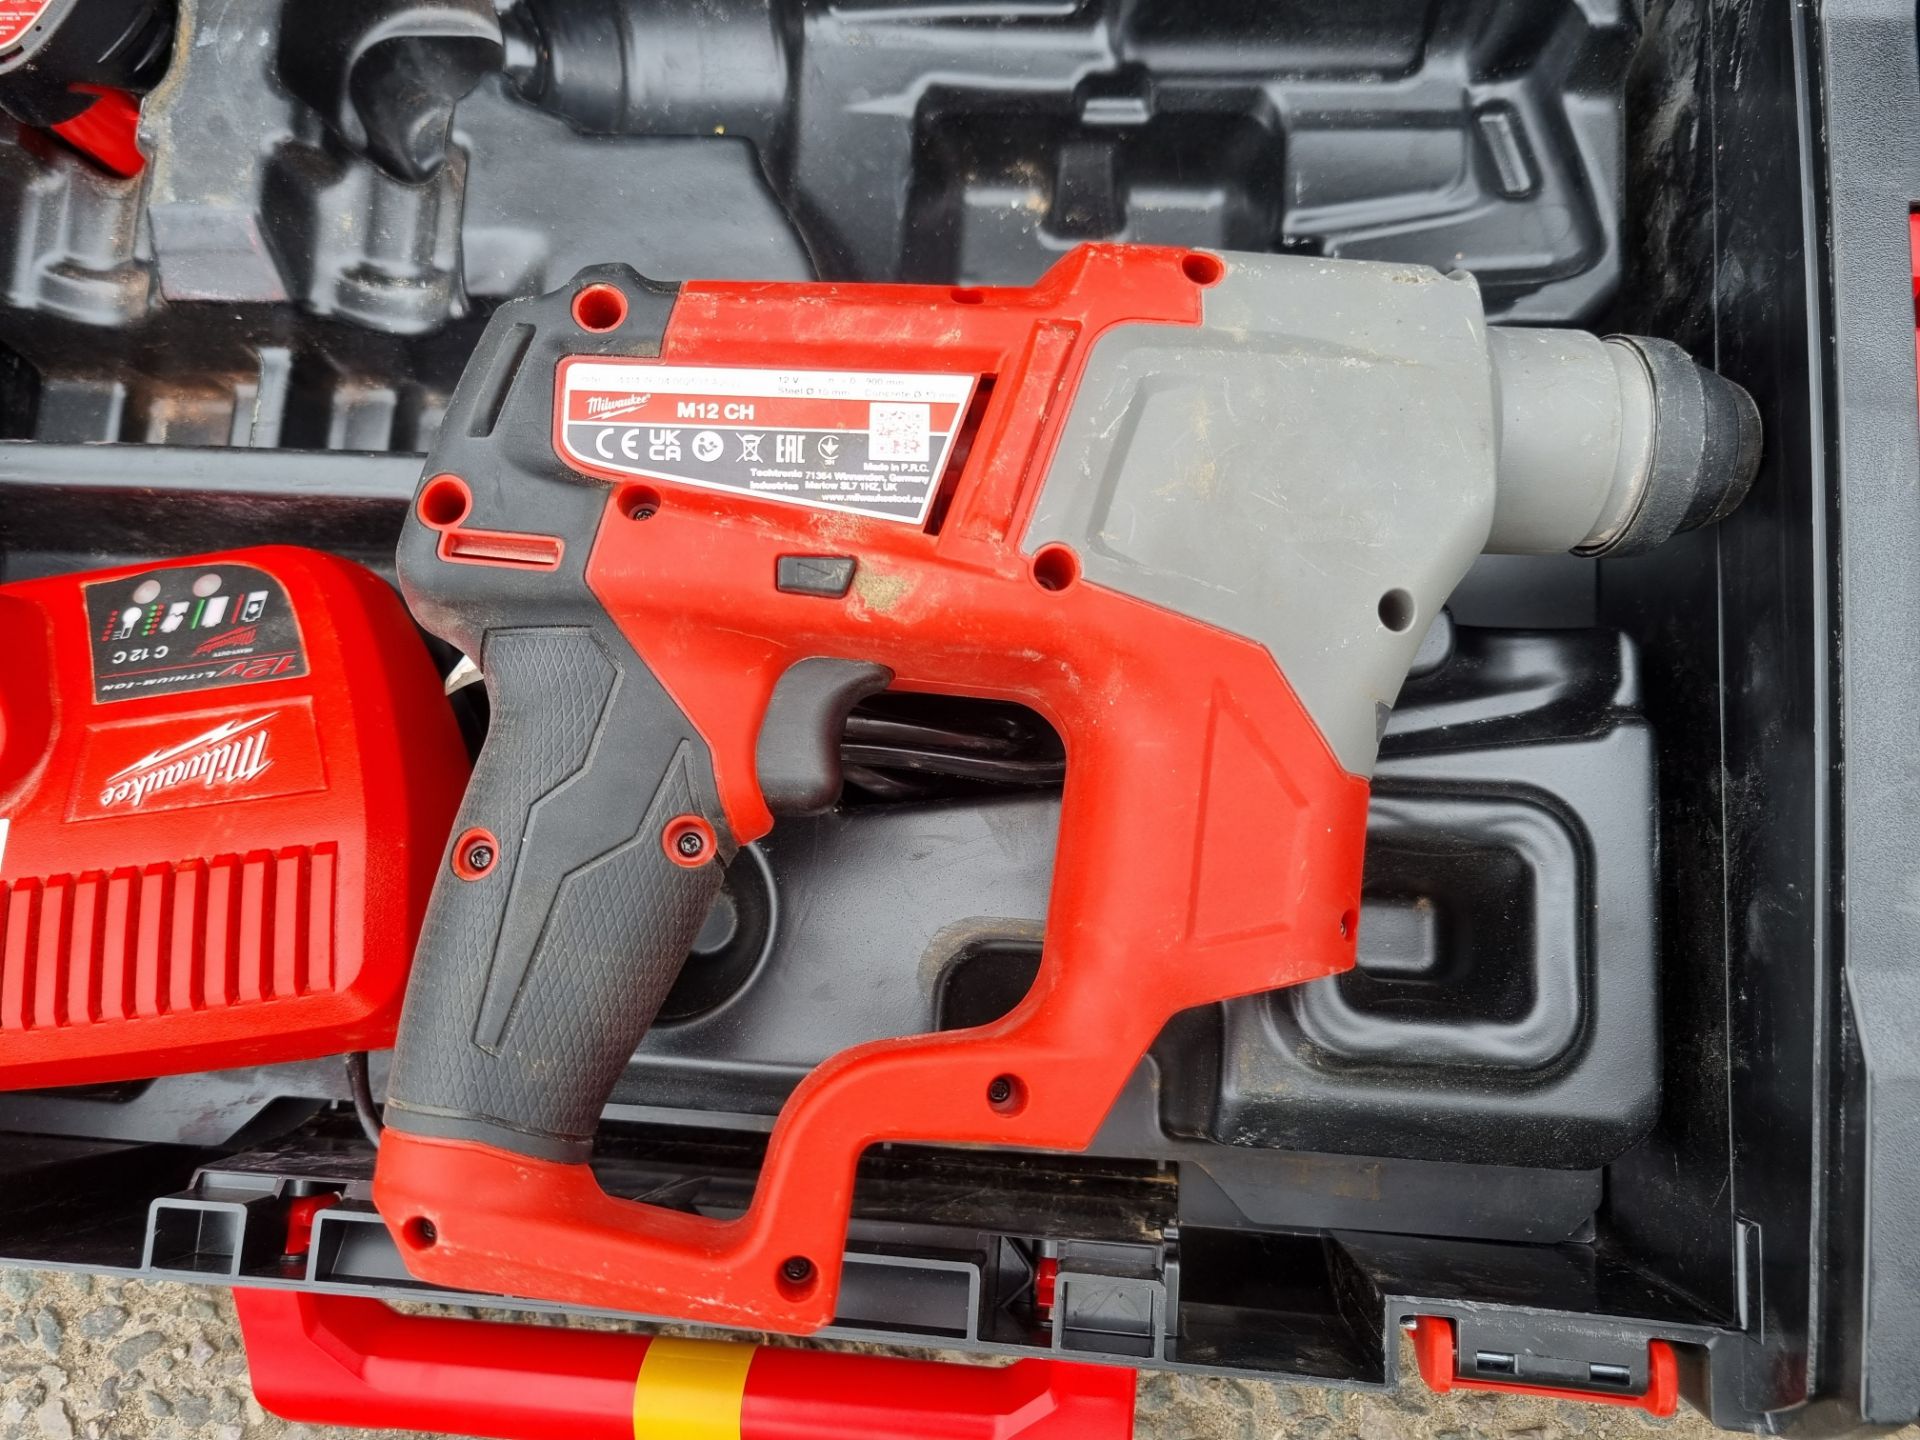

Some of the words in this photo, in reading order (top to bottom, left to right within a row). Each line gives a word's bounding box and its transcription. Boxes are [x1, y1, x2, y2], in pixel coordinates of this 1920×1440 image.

[585, 394, 648, 416] Milwaukee
[677, 402, 719, 419] M12
[723, 404, 755, 420] CH
[595, 428, 640, 460] CE
[649, 429, 681, 446] UK
[649, 445, 681, 461] CA
[750, 468, 803, 478] Techtronic
[863, 462, 890, 472] Made
[891, 463, 899, 472] in
[900, 463, 929, 473] P.R.C.
[888, 473, 930, 485] Germany
[882, 483, 898, 492] UK
[192, 628, 257, 656] Milwaukee
[111, 650, 128, 665] C
[129, 647, 150, 662] 12
[152, 645, 169, 659] C
[99, 729, 276, 808] Milwaukee
